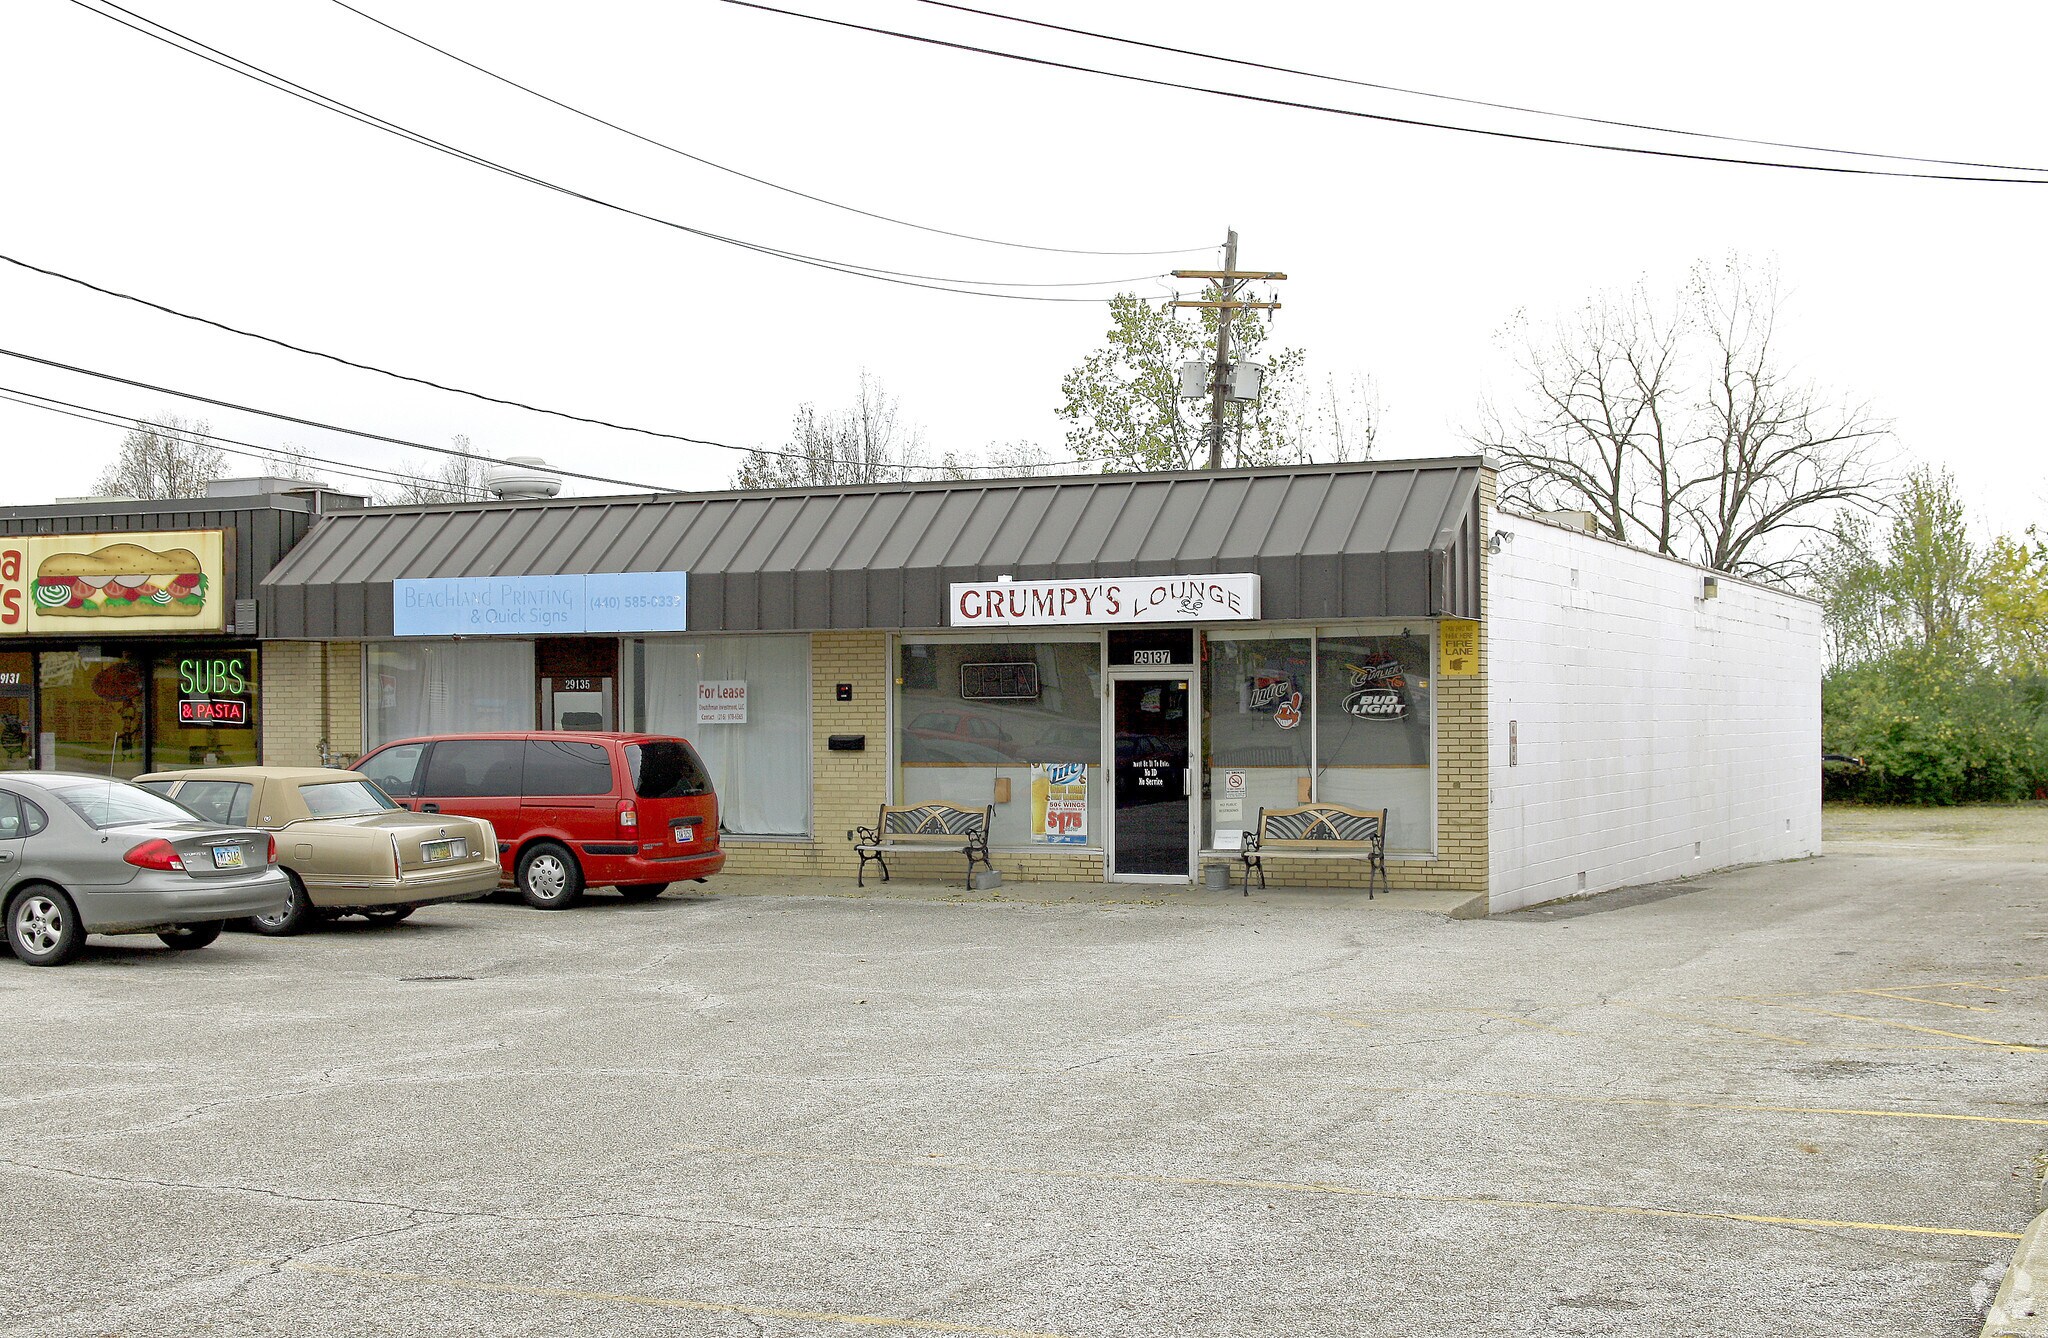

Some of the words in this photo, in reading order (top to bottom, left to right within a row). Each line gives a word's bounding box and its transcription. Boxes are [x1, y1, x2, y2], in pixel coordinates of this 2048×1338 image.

[0, 550, 21, 582] a
[959, 585, 1121, 619] GRUMPY'S
[1134, 581, 1241, 618] LOUNGE
[470, 608, 481, 624] &
[485, 608, 526, 624] Quick
[529, 607, 568, 627] Signs
[1445, 640, 1473, 648] FIRE
[1134, 651, 1170, 664] 29137
[1445, 647, 1474, 656] LANE
[180, 659, 243, 694] SUBS
[964, 665, 1035, 696] OPEN
[565, 679, 591, 690] 29135
[698, 684, 715, 699] For
[717, 684, 745, 699] Lease
[1359, 695, 1399, 705] BUD
[182, 703, 193, 718] &
[197, 703, 240, 718] PASTA
[1351, 704, 1406, 714] LIGHT
[1049, 762, 1078, 785] Lite
[1144, 768, 1151, 777] No
[1151, 768, 1158, 777] ID
[1138, 777, 1145, 786] No
[1145, 777, 1163, 786] Service
